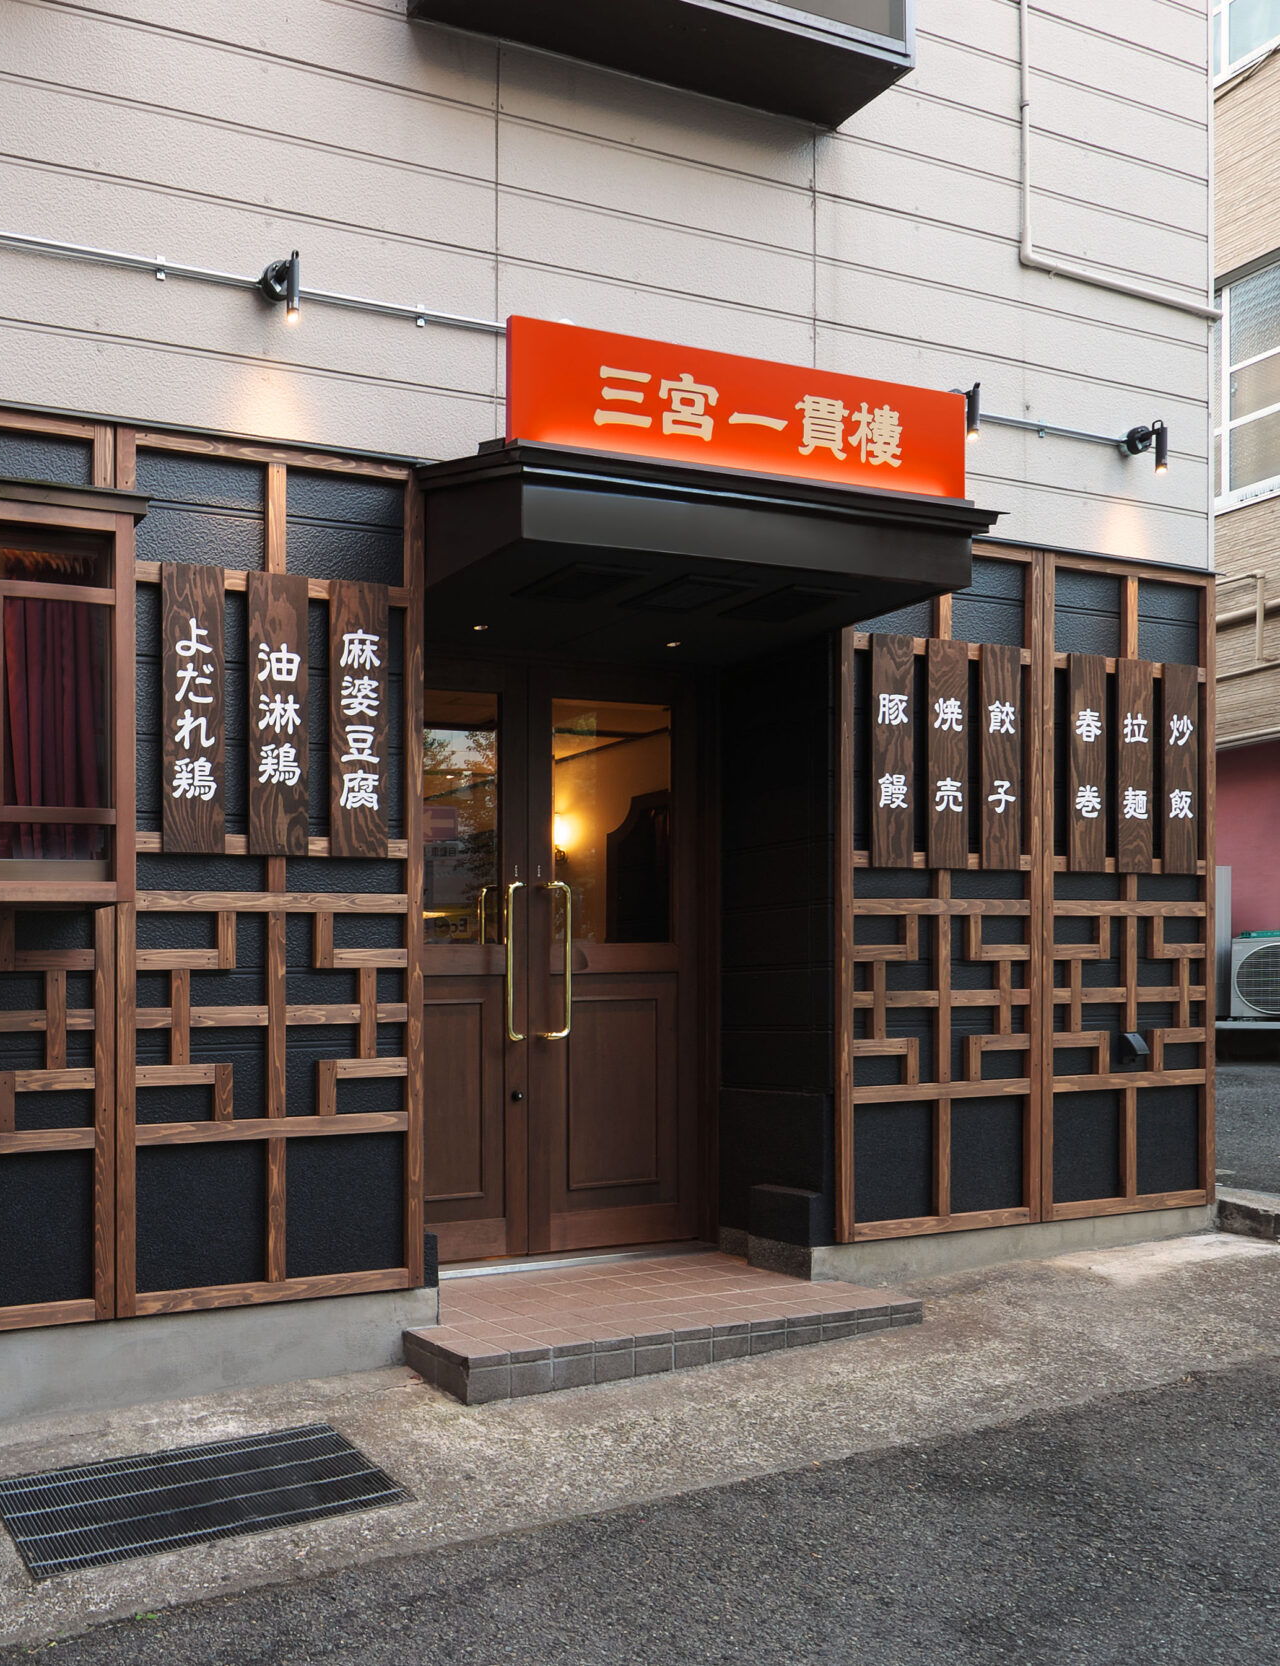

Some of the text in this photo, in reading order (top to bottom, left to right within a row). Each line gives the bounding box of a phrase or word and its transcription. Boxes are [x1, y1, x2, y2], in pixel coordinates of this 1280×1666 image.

[593, 365, 903, 468] 三宮一貫樓
[171, 617, 218, 802] よだれ鶏
[257, 642, 302, 787] 油淋鶏
[339, 628, 381, 811] 麻婆豆腐
[877, 693, 909, 809] 豚饅
[933, 697, 964, 813] 焼売
[987, 700, 1017, 814] 餃子
[1074, 707, 1102, 819] 春巻
[1122, 712, 1149, 820] 拉麺
[1168, 714, 1194, 819] 炒飯
